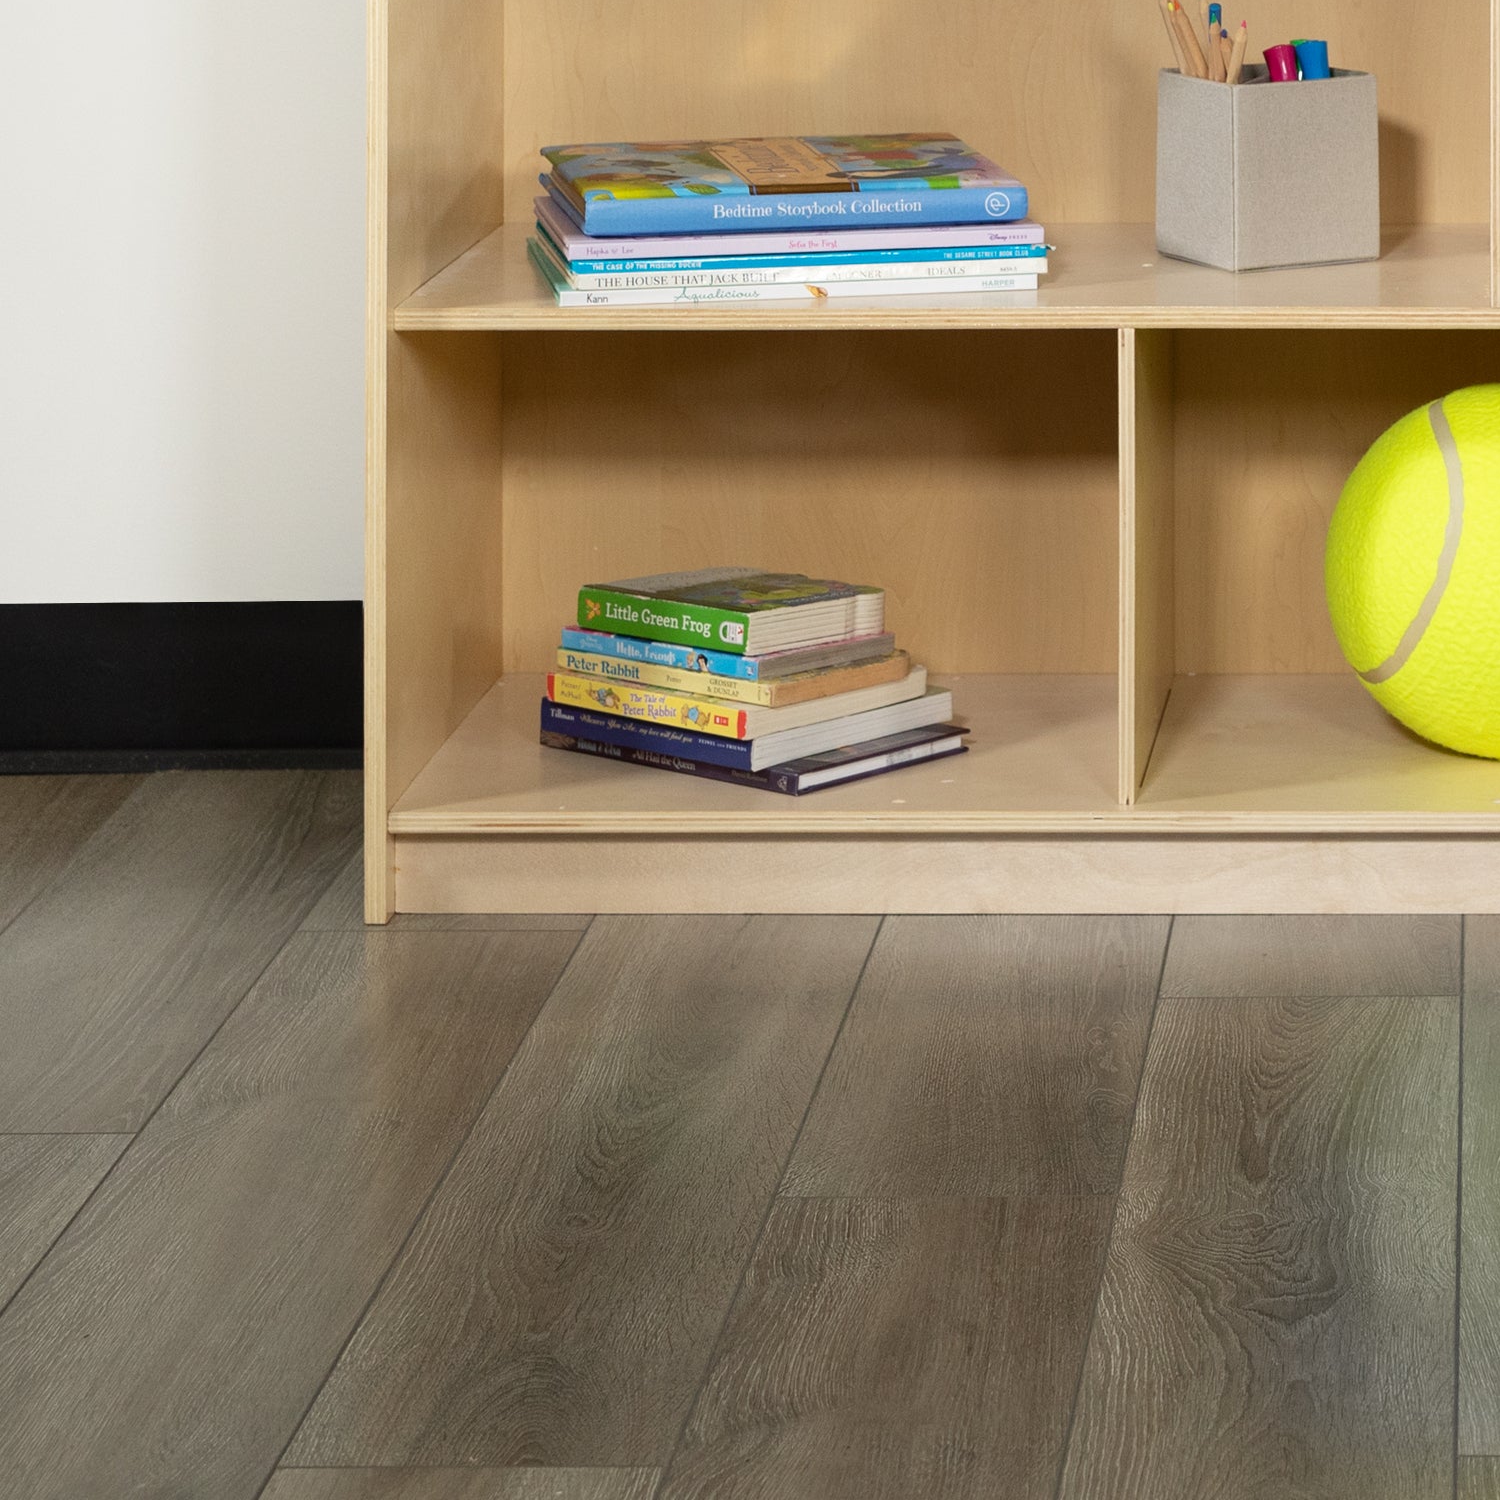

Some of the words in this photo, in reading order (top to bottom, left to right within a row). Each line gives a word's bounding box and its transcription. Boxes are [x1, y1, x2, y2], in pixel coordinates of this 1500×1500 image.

[713, 203, 772, 219] Bedtime
[776, 200, 847, 219] Storybook
[850, 199, 922, 214] Collection
[592, 262, 604, 271] THE
[606, 262, 622, 270] CASE
[626, 262, 634, 270] OF
[636, 262, 647, 270] THE
[927, 266, 966, 276] IDEALS
[595, 278, 623, 288] THE
[625, 276, 668, 287] HOUSE
[671, 274, 707, 285] THAT
[709, 273, 738, 286] JACK
[586, 293, 608, 304] Kann
[674, 287, 760, 304] Aqualicious
[981, 280, 1015, 288] HARPER
[605, 602, 638, 622] Little
[641, 609, 679, 629] Green
[682, 615, 712, 638] Frog
[566, 654, 598, 672] Peter
[601, 660, 640, 679] Rabbit
[710, 679, 737, 689] GROSSET
[714, 686, 740, 696] DUNLAP
[630, 694, 642, 702] The
[644, 694, 657, 703] Tale
[658, 695, 666, 703] of
[550, 708, 575, 721] Tillman
[622, 703, 644, 716] Peter
[647, 705, 676, 719] Rabbit
[660, 730, 670, 738] will
[726, 743, 747, 752] FRIENDS
[673, 757, 696, 771] Queen
